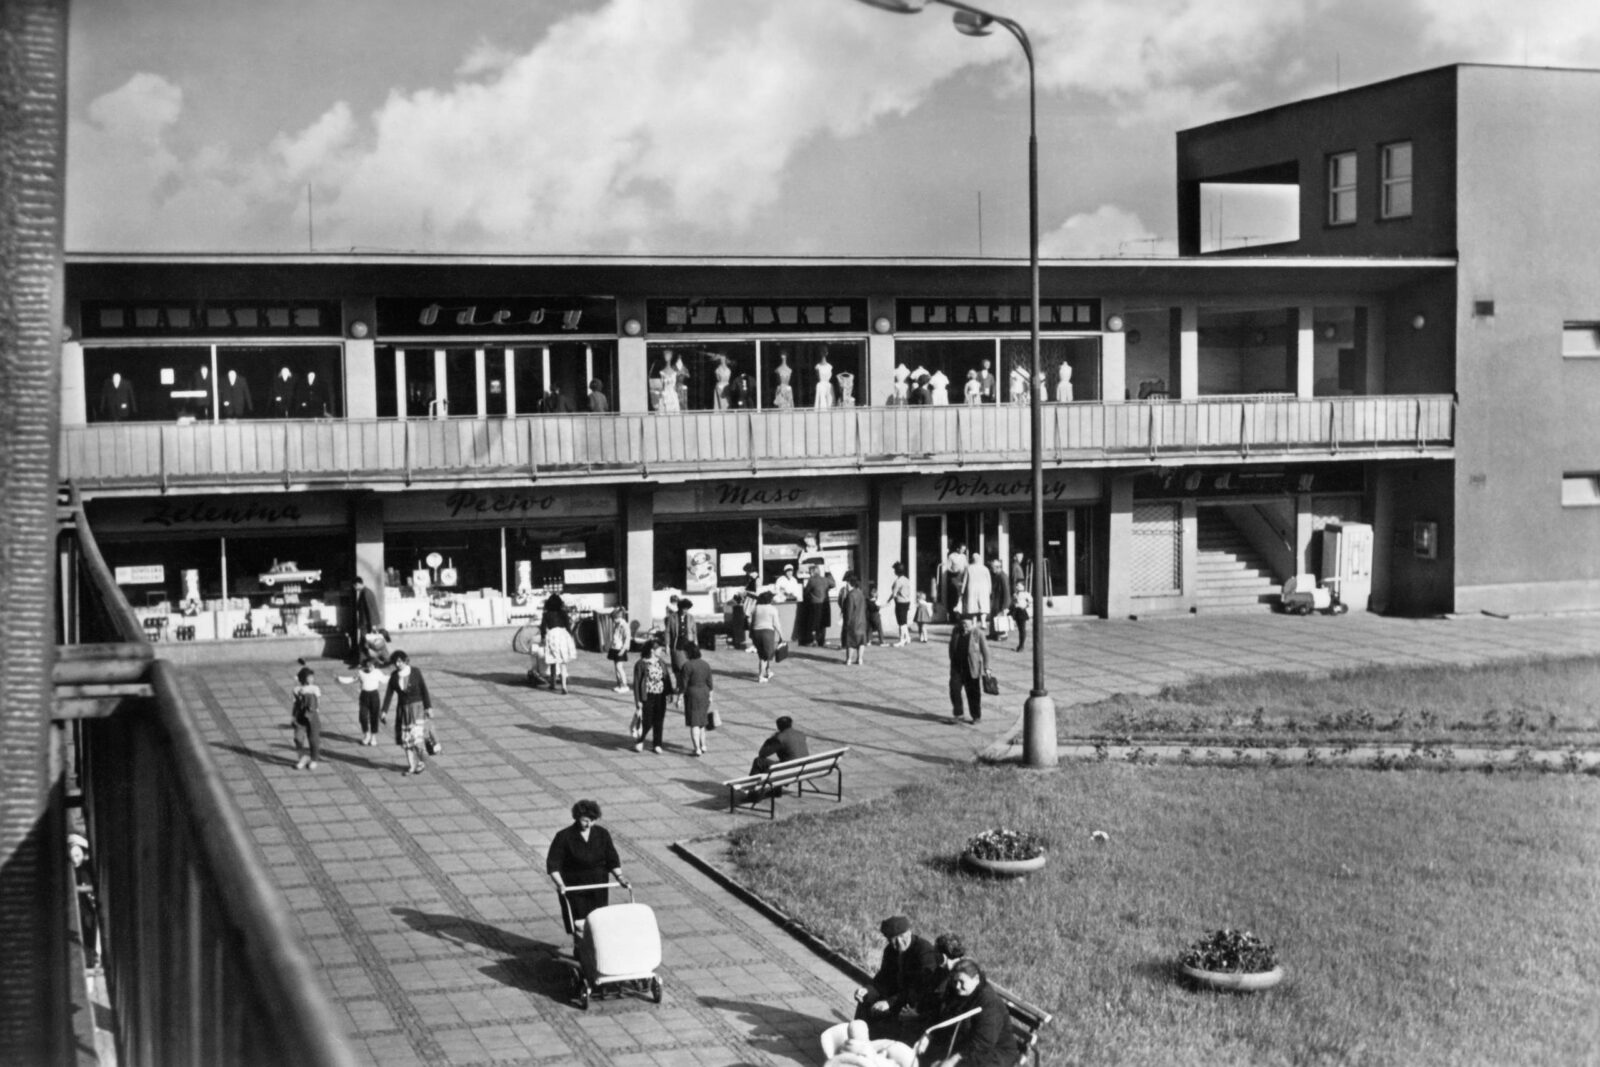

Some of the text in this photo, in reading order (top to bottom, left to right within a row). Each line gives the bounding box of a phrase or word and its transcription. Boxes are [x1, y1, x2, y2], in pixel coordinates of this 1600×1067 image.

[446, 490, 556, 517] Pečivo
[714, 483, 808, 504] Maso
[142, 500, 301, 526] Zelenina
